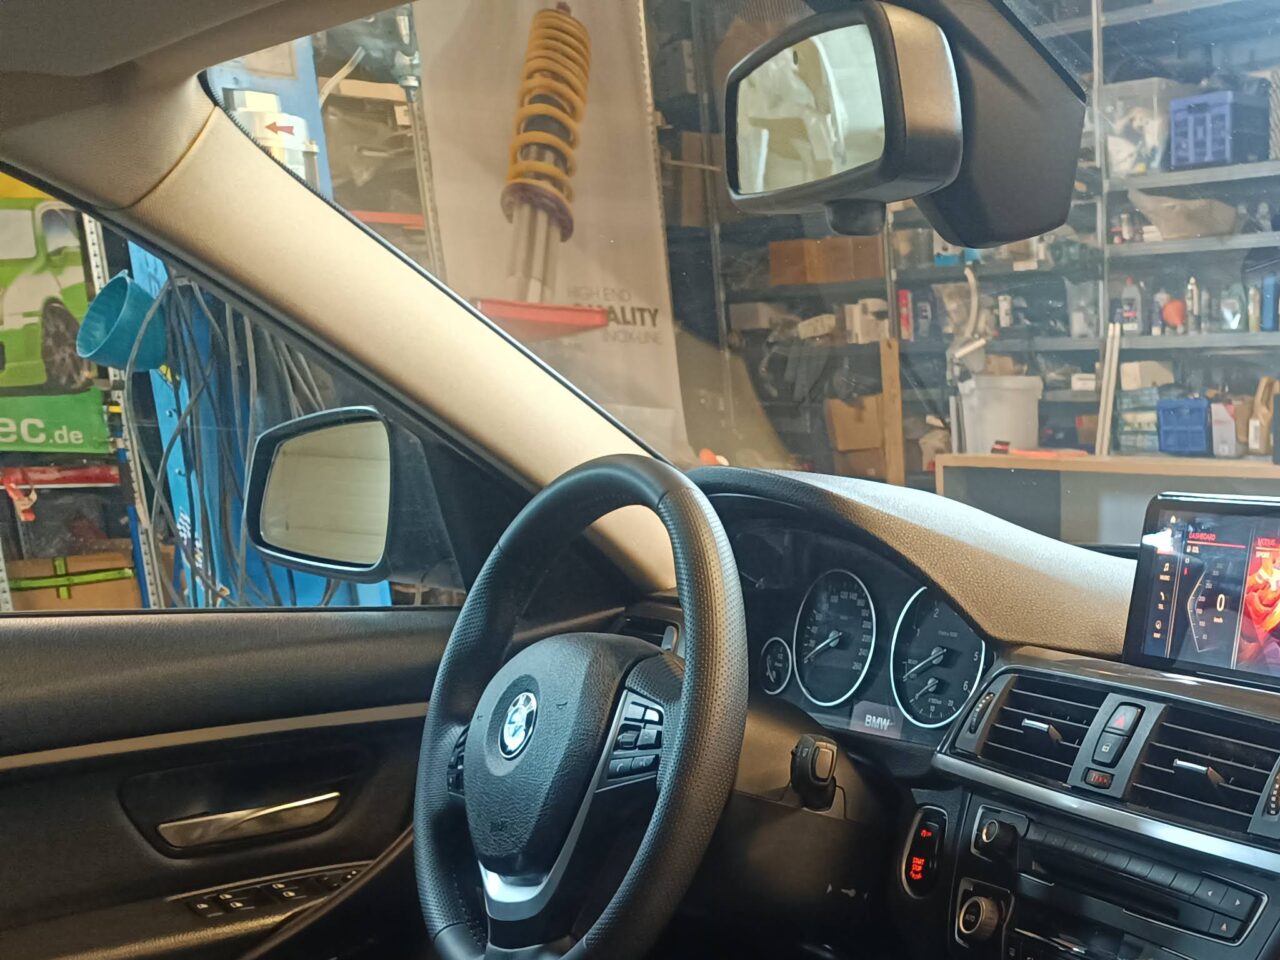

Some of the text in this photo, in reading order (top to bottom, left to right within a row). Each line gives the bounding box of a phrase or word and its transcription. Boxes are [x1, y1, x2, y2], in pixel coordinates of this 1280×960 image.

[1216, 593, 1226, 612] 0
[933, 607, 940, 618] 2
[973, 651, 980, 662] 5
[962, 680, 969, 692] 6
[864, 714, 890, 731] BMW
